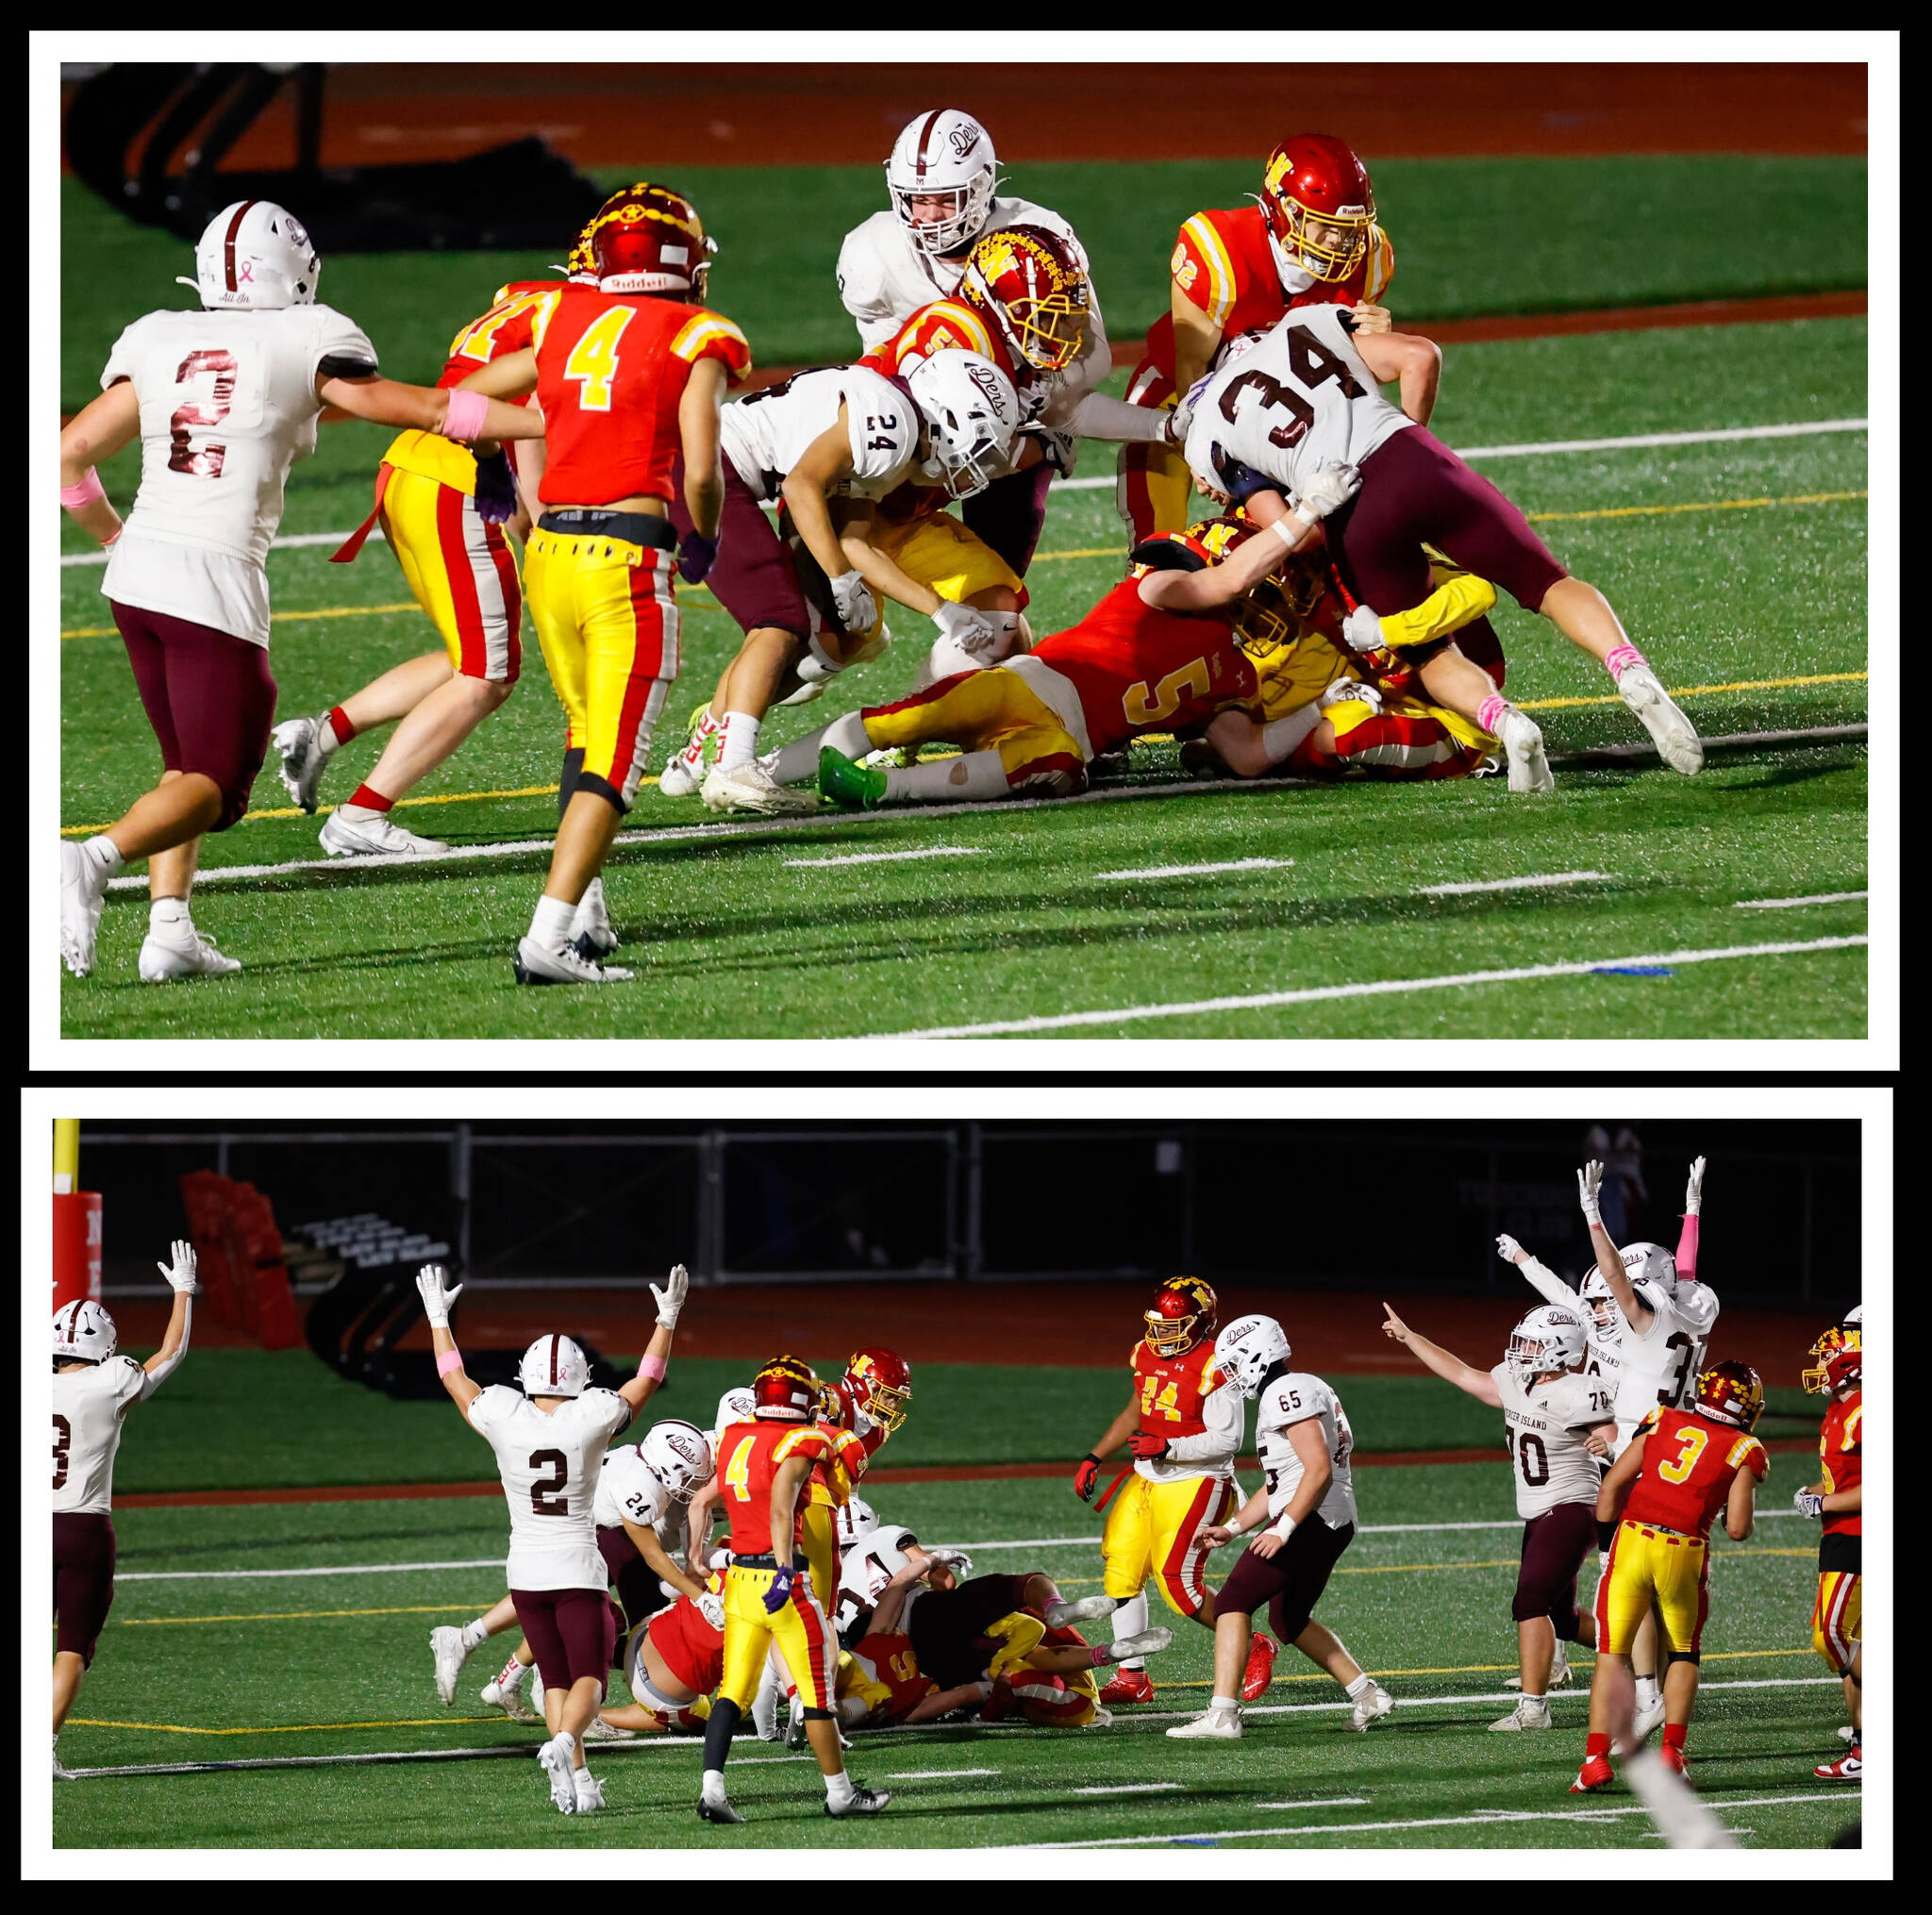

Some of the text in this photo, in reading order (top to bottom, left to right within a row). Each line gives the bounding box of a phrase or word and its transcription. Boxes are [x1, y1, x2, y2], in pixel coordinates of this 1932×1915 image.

[949, 124, 979, 156] Ders
[978, 243, 1020, 287] N
[1170, 242, 1199, 291] 62
[563, 305, 638, 411] 4
[971, 366, 1008, 418] Ders
[1218, 324, 1368, 449] 34
[167, 349, 239, 478] 2
[866, 413, 898, 453] 24
[1122, 656, 1211, 725] 5
[1620, 1253, 1641, 1265] ers
[1227, 1324, 1253, 1344] Ders
[1547, 1311, 1574, 1323] Ders
[1141, 1375, 1182, 1423] 74
[1278, 1390, 1302, 1412] 65
[1589, 1391, 1609, 1411] 70
[1521, 1415, 1547, 1430] ISLAND
[669, 1435, 697, 1464] Ders
[725, 1436, 757, 1502] 4
[1658, 1426, 1708, 1485] 3
[528, 1448, 569, 1517] 2
[625, 1491, 651, 1517] 24
